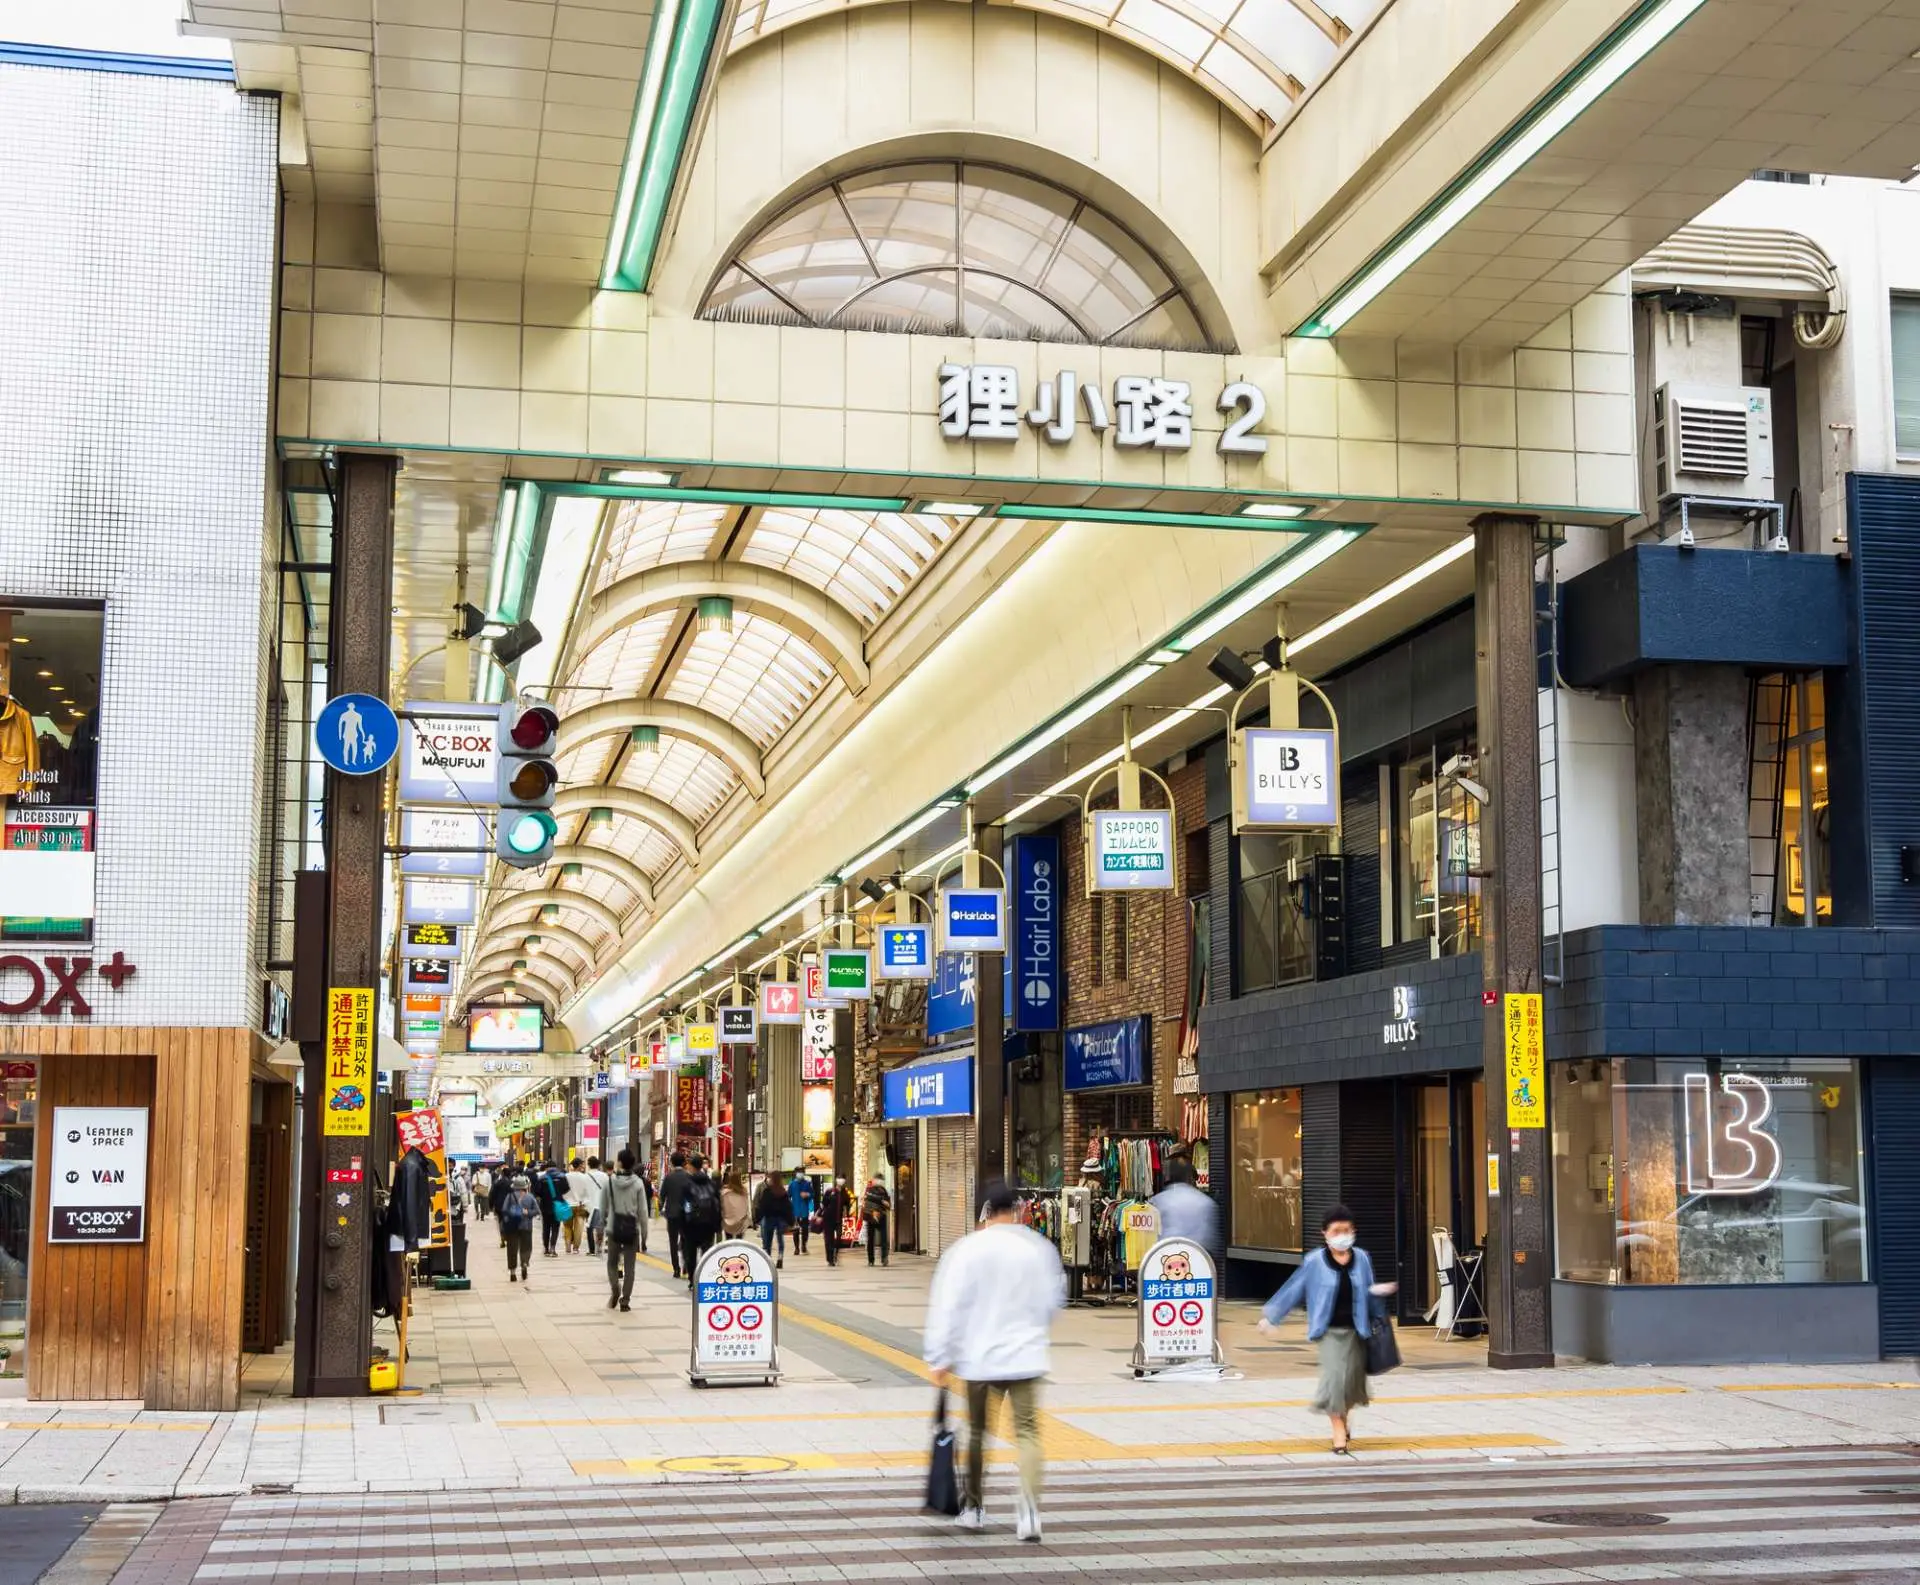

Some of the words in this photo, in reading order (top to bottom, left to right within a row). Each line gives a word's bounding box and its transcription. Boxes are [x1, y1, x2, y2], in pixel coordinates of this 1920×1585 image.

[938, 363, 1194, 452] 狸小路
[1216, 381, 1269, 457] 2
[422, 755, 485, 768] MARUFUJI
[19, 768, 59, 784] Jacket
[1259, 773, 1322, 790] BILLY'S
[17, 788, 51, 804] Pants
[445, 782, 460, 798] 2
[15, 810, 79, 827] Accessory
[1285, 805, 1299, 820] 2
[16, 828, 39, 844] And
[40, 831, 55, 844] so
[1106, 822, 1159, 834] SAPPORO
[1109, 836, 1158, 849] エルムビル
[331, 993, 352, 1078] 通行禁止
[354, 993, 369, 1078] 許可車両以外
[1383, 1019, 1416, 1044] BILLY'S
[1510, 998, 1522, 1078] ご通行ください
[1527, 998, 1539, 1077] 自転車から降りて
[86, 1126, 134, 1136] LEATHER
[92, 1137, 125, 1146] SPACE
[91, 1170, 125, 1184] VAN
[1132, 1214, 1153, 1228] 1000
[703, 1285, 769, 1301] 歩行者専用
[1147, 1282, 1208, 1298] 歩行者専用
